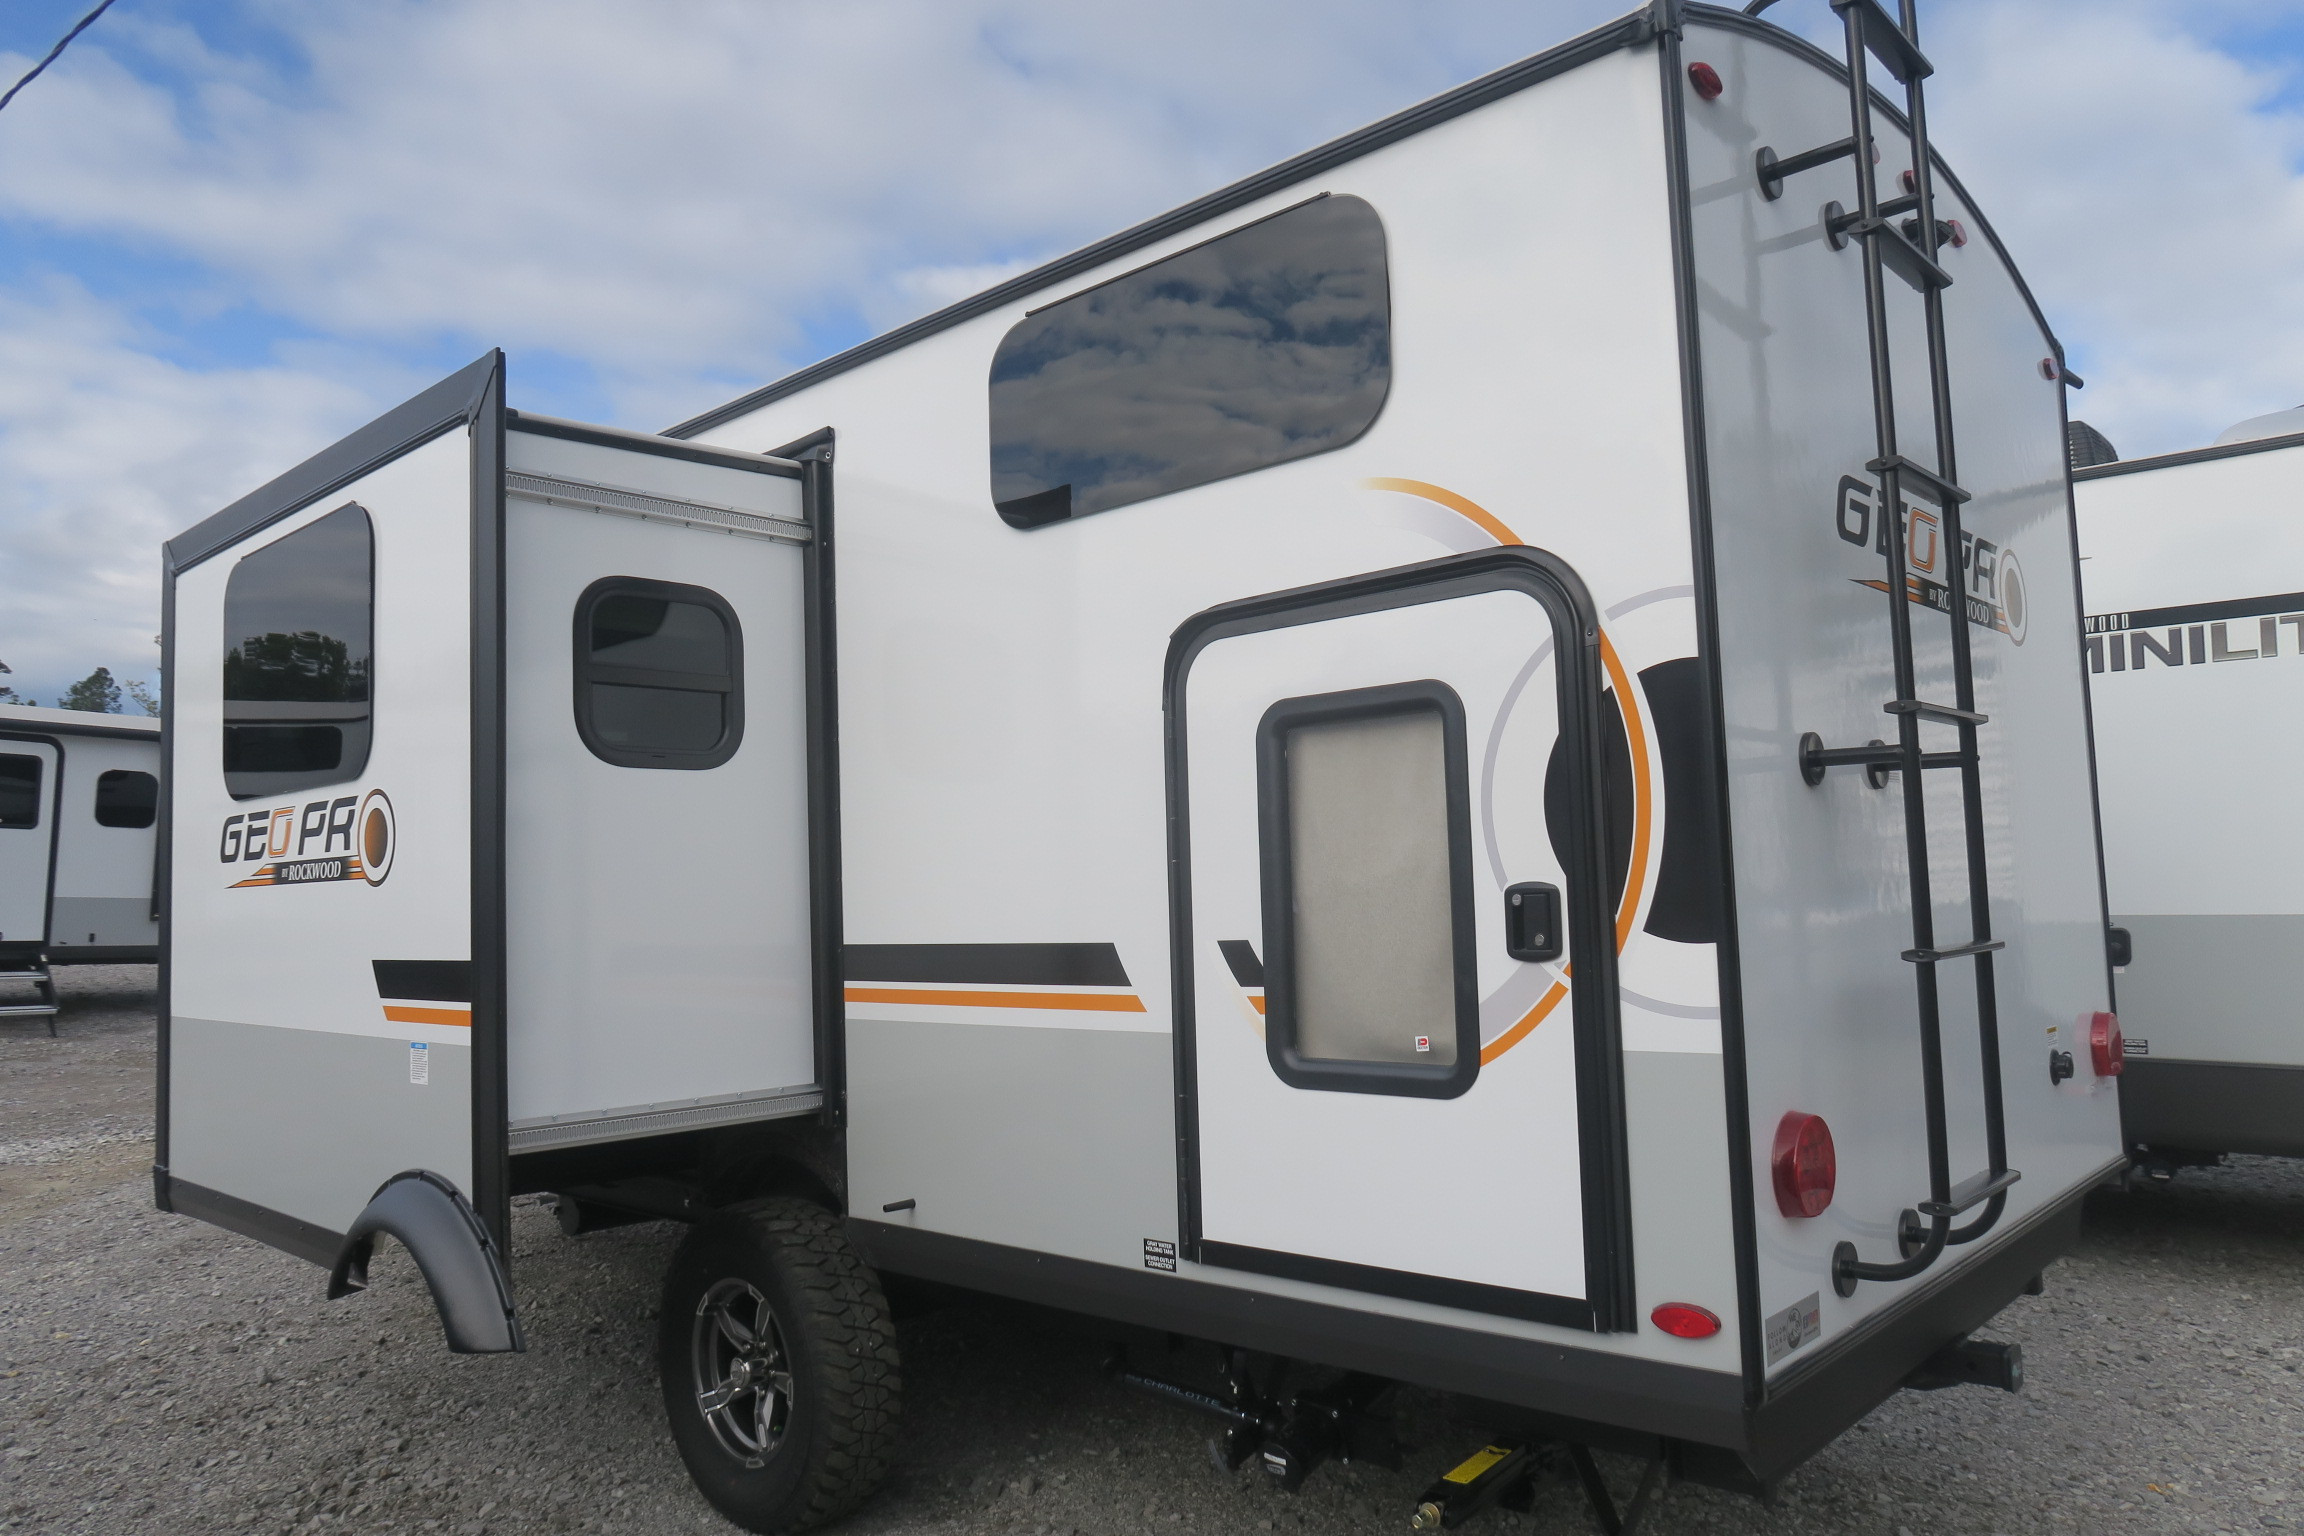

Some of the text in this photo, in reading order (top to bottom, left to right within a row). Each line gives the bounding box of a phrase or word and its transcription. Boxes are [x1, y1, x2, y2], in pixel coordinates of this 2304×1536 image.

[1938, 588, 1989, 623] ROOOD
[220, 789, 396, 887] GEO PRO
[288, 861, 341, 880] ROCKWOOD
[1144, 1378, 1221, 1408] CHARLOTTE
